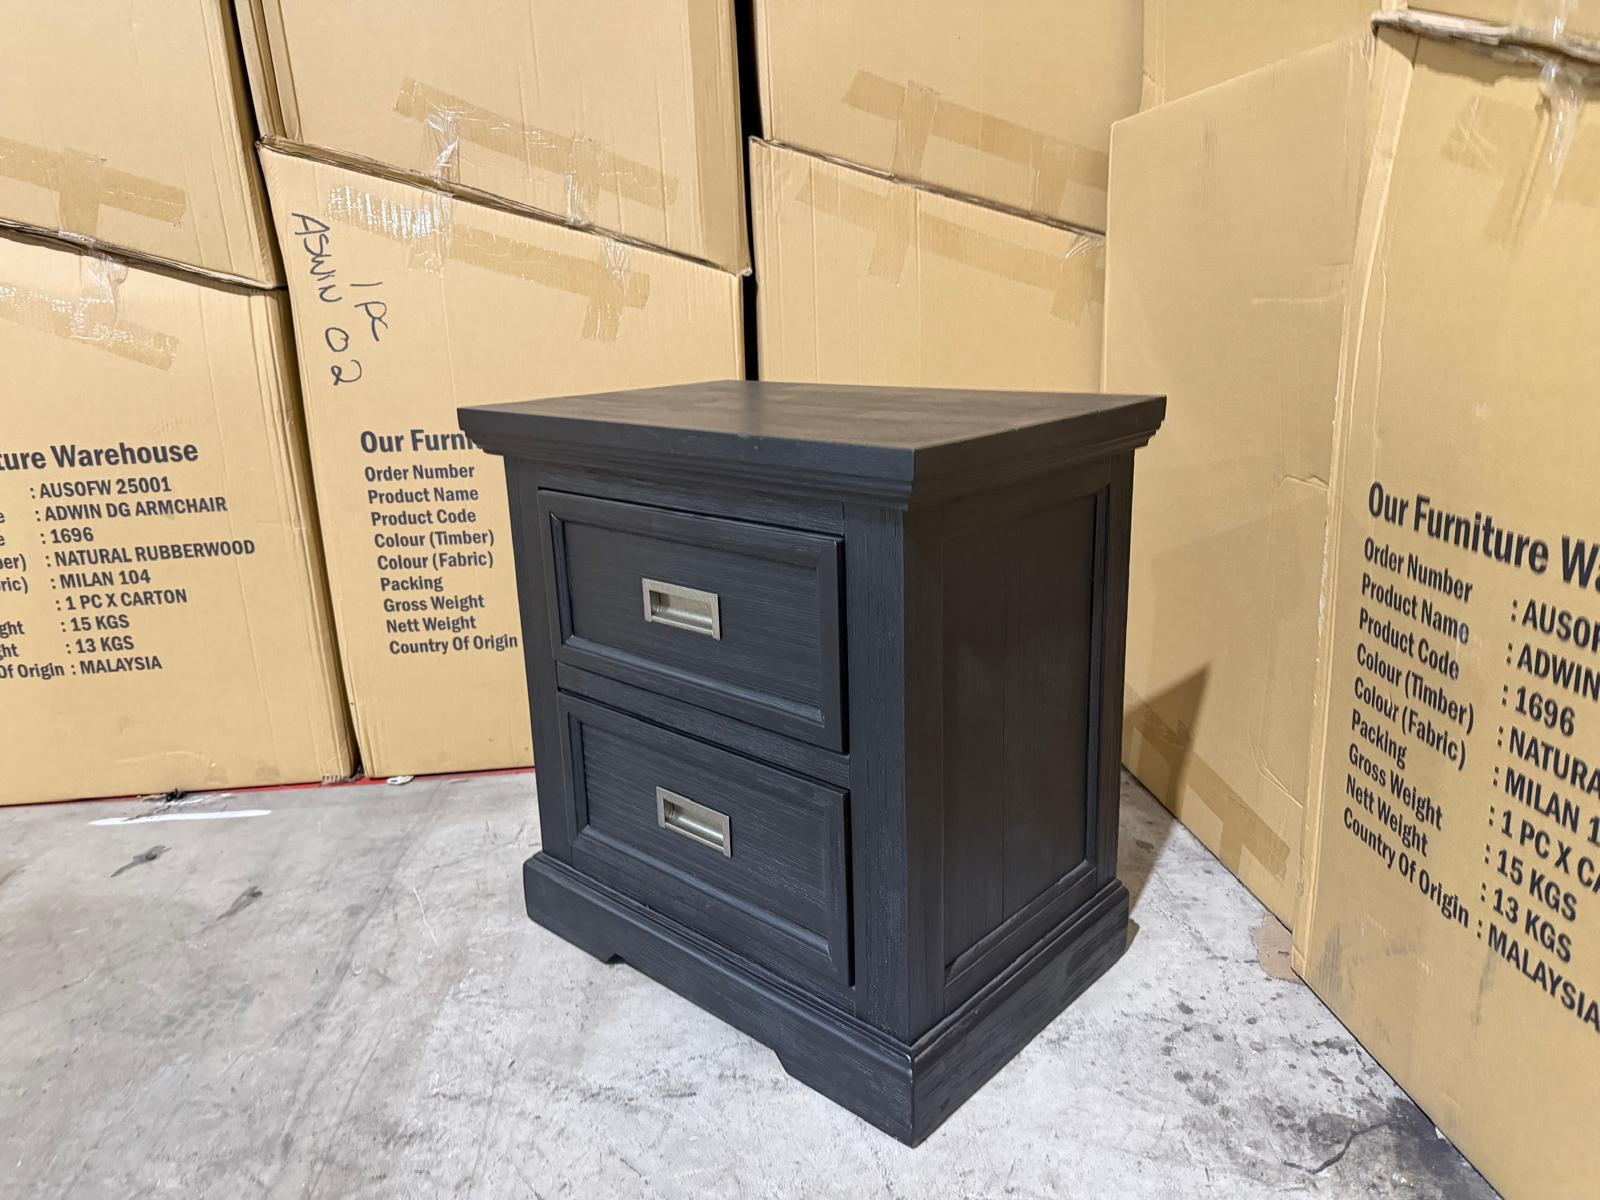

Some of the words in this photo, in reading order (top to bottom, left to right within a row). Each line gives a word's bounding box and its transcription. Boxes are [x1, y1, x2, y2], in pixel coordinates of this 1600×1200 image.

[361, 431, 404, 453] Our
[50, 442, 198, 468] Warehouse
[365, 466, 409, 482] Order
[413, 464, 474, 479] Number
[40, 480, 111, 498] AUSOFW
[116, 476, 172, 494] 25001
[368, 488, 430, 504] Product
[433, 487, 478, 501] Name
[45, 504, 102, 521] ADWIN
[106, 502, 131, 518] DG
[136, 497, 227, 516] ARMCHAIR
[371, 510, 433, 526] Product
[437, 508, 476, 523] Code
[51, 527, 94, 543] 1696
[375, 533, 425, 548] Colour
[430, 529, 494, 549] (Timber)
[1369, 481, 1409, 527] Our
[1414, 494, 1548, 575] Furniture
[54, 548, 132, 567] NATURAL
[135, 540, 255, 562] RUBBERWOOD
[378, 555, 428, 570] Colour
[433, 551, 493, 571] (Fabric)
[59, 571, 114, 589] MILAN
[119, 569, 151, 585] 104
[1365, 537, 1404, 575] Order
[1407, 553, 1473, 603] Number
[381, 576, 443, 592] Packing
[80, 594, 102, 609] PC
[105, 593, 118, 608] X
[121, 589, 187, 606] CARTON
[384, 599, 428, 612] Gross
[430, 595, 485, 612] Weight
[71, 617, 91, 631] 15
[95, 614, 129, 630] KGS
[386, 619, 420, 633] Nett
[422, 616, 477, 633] Weight
[76, 638, 96, 653] 13
[100, 635, 134, 652] KGS
[390, 639, 448, 654] Country
[453, 636, 469, 651] Of
[473, 634, 518, 651] Origin
[1362, 572, 1418, 621] Product
[1421, 599, 1469, 645] Name
[1517, 643, 1600, 702] ADWIN
[17, 663, 65, 680] Origin
[80, 656, 162, 674] MALAYSIA
[1359, 607, 1415, 658] Product
[1418, 638, 1459, 680] Code
[1515, 686, 1575, 738] 1696
[1357, 643, 1402, 687] Colour
[1405, 670, 1473, 736] (Timber)
[1353, 675, 1400, 724] Colour
[1401, 704, 1468, 772] (Fabric)
[1504, 766, 1580, 834] MILAN
[1351, 708, 1408, 771] Packing
[1520, 819, 1550, 859] PC
[1554, 840, 1572, 875] X
[1349, 743, 1386, 787] Gross
[1390, 769, 1442, 832] Weight
[1497, 849, 1523, 886] 15
[1529, 868, 1577, 922] KGS
[1346, 773, 1374, 815] Nett
[1377, 797, 1429, 859] Weight
[1493, 888, 1519, 924] 13
[1525, 909, 1571, 963] KGS
[1344, 807, 1398, 869] Country
[1399, 852, 1416, 883] Of
[1419, 869, 1469, 928] Origin
[1488, 921, 1600, 1033] MALAYSIA
